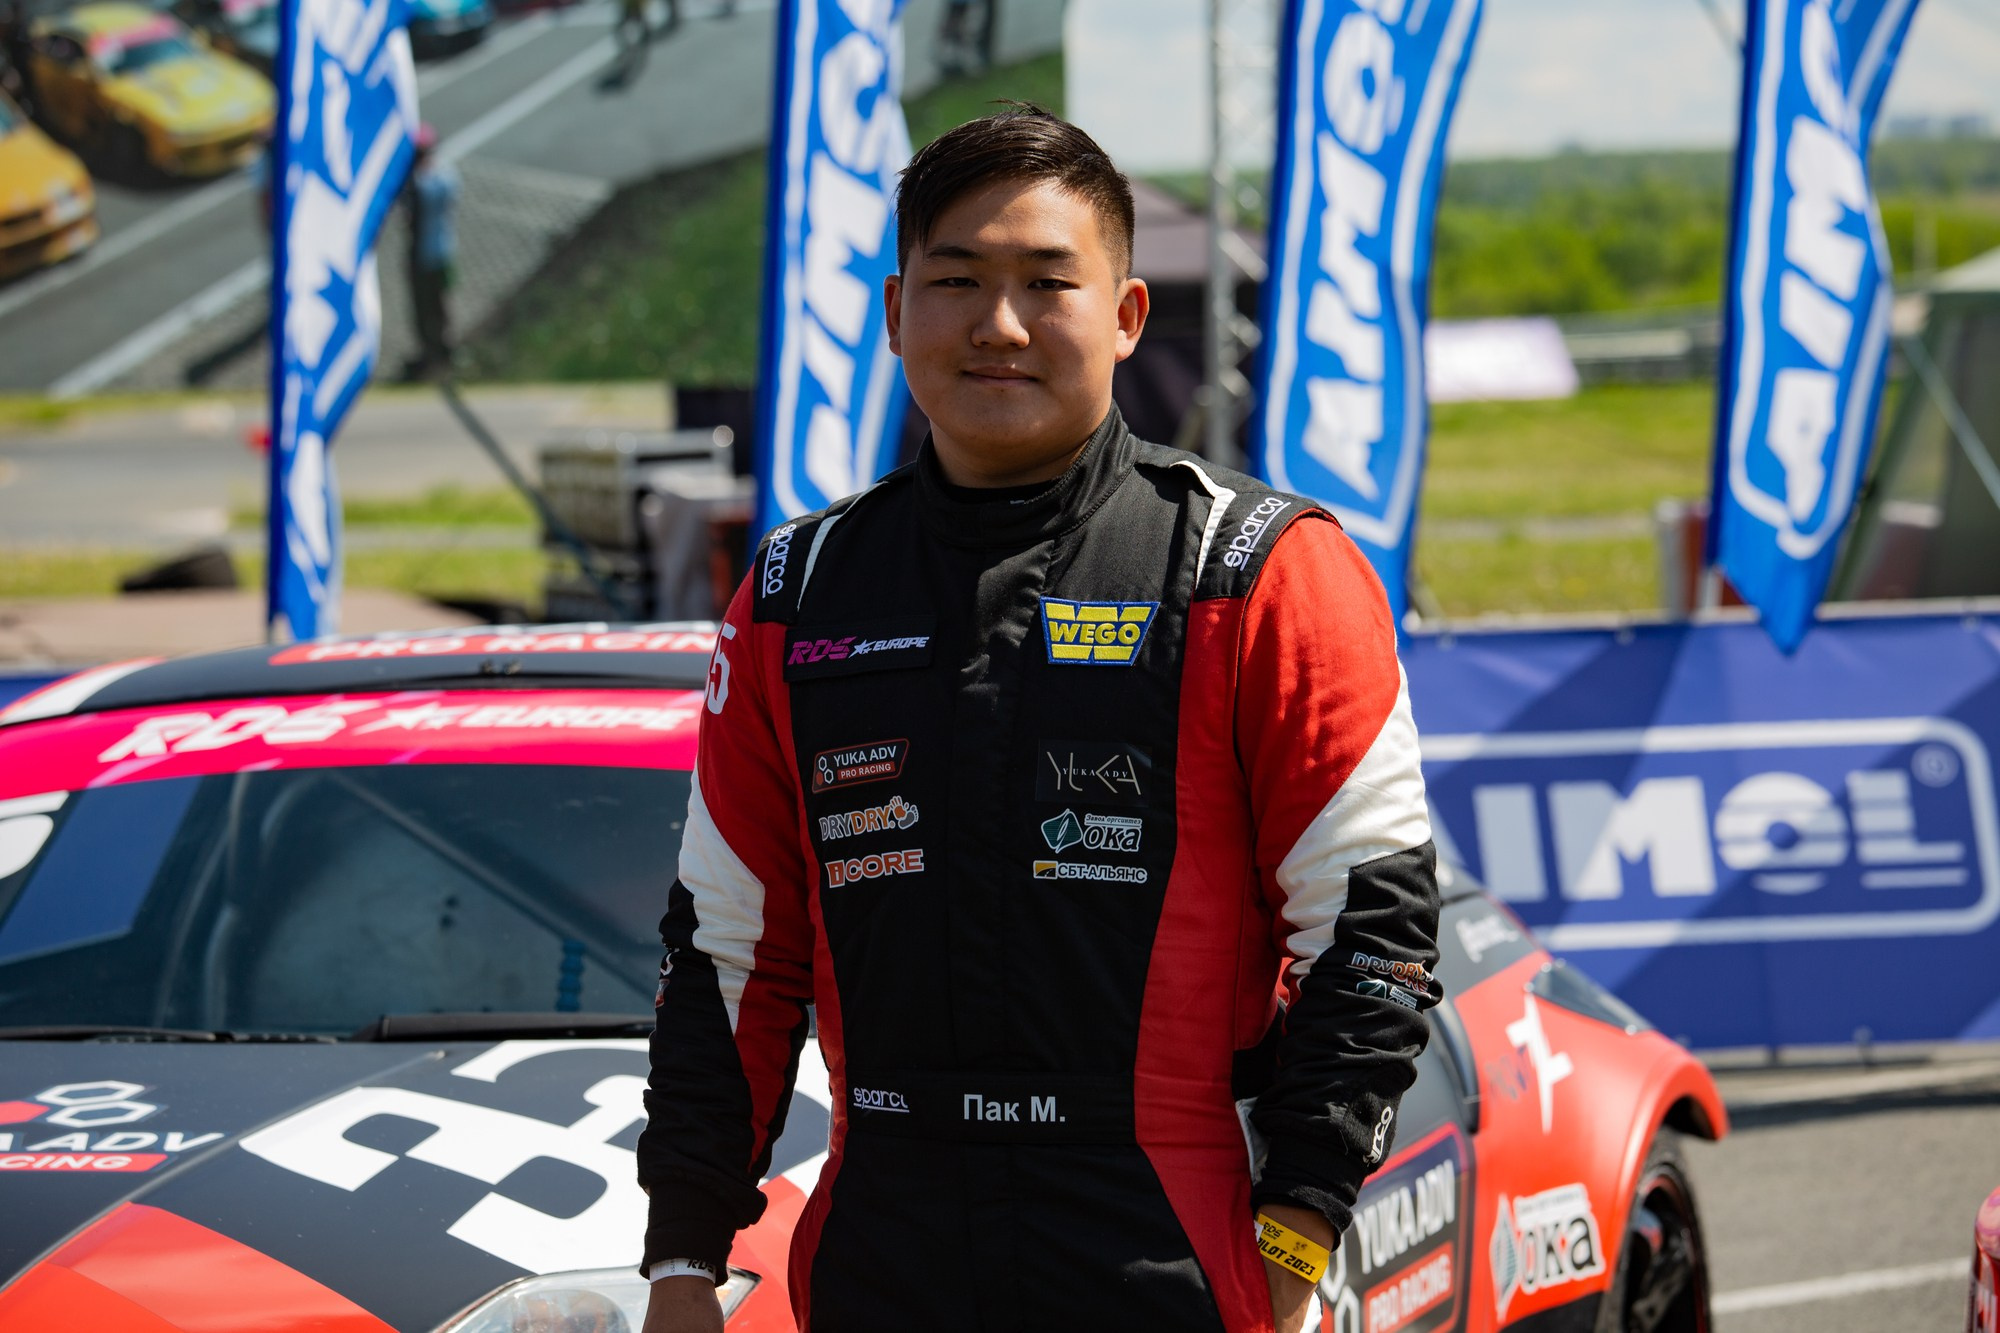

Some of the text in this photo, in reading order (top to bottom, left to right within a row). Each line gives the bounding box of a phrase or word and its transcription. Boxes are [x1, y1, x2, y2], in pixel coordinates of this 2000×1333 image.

[1302, 0, 1431, 500] AIMO
[1223, 497, 1288, 571] sparco
[763, 524, 797, 597] sparco
[485, 632, 719, 652] RACIN
[1049, 621, 1141, 645] WEGO
[787, 636, 930, 665] RDS EUROPE
[704, 622, 736, 715] 5
[98, 699, 697, 763] RDS EUROPE
[834, 745, 897, 768] YUKA ADV
[840, 763, 892, 779] PRO RACING
[1424, 768, 1970, 903] IMOL
[1057, 863, 1148, 884] СБТ-АЛЬЯНС
[963, 1094, 1066, 1123] Пак М.
[1264, 1222, 1284, 1238] RDS
[1354, 1158, 1456, 1275] YUKA ADV
[1258, 1238, 1316, 1276] ILOT 2023
